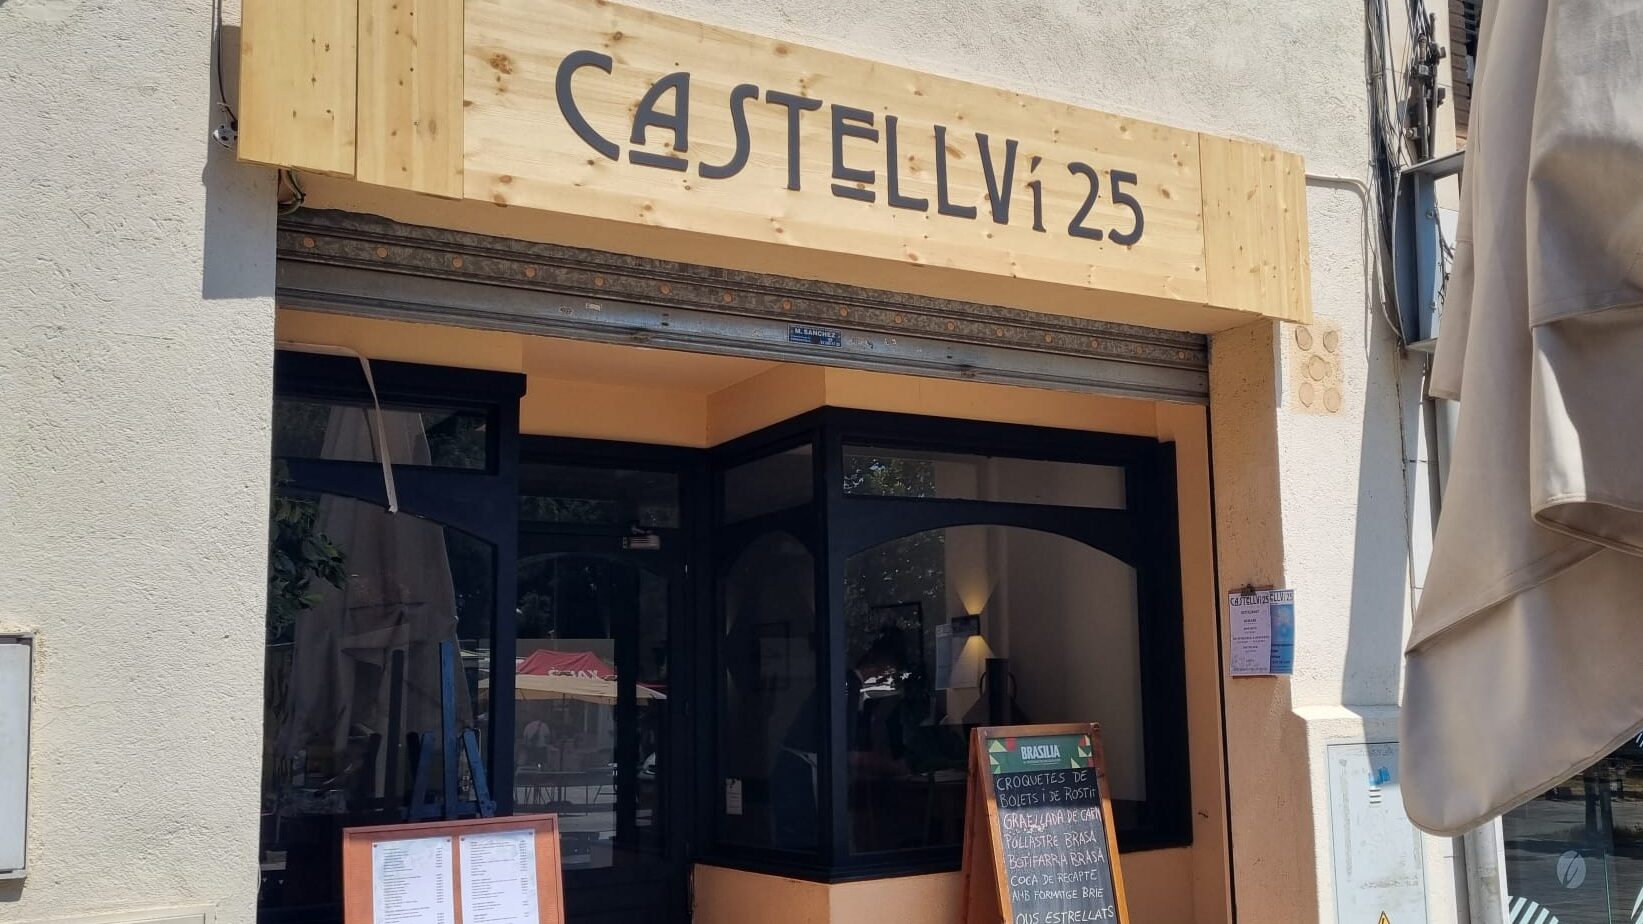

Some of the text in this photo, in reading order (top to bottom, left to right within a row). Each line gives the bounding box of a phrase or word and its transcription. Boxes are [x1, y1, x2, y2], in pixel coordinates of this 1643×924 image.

[1067, 162, 1144, 246] 25
[1021, 744, 1060, 760] BRASILIA
[996, 770, 1088, 791] CROQUETES DE
[1000, 792, 1039, 808] BOLETS
[1049, 790, 1061, 802] DE
[1003, 809, 1064, 830] GRAELLADA
[1067, 809, 1077, 823] DE
[1004, 830, 1097, 850] POLLASTRE BRASA
[1070, 848, 1105, 867] BRASA
[1010, 869, 1097, 887] COCA DE RECAPTE
[1016, 905, 1115, 924] OUS ESTRELLATS
